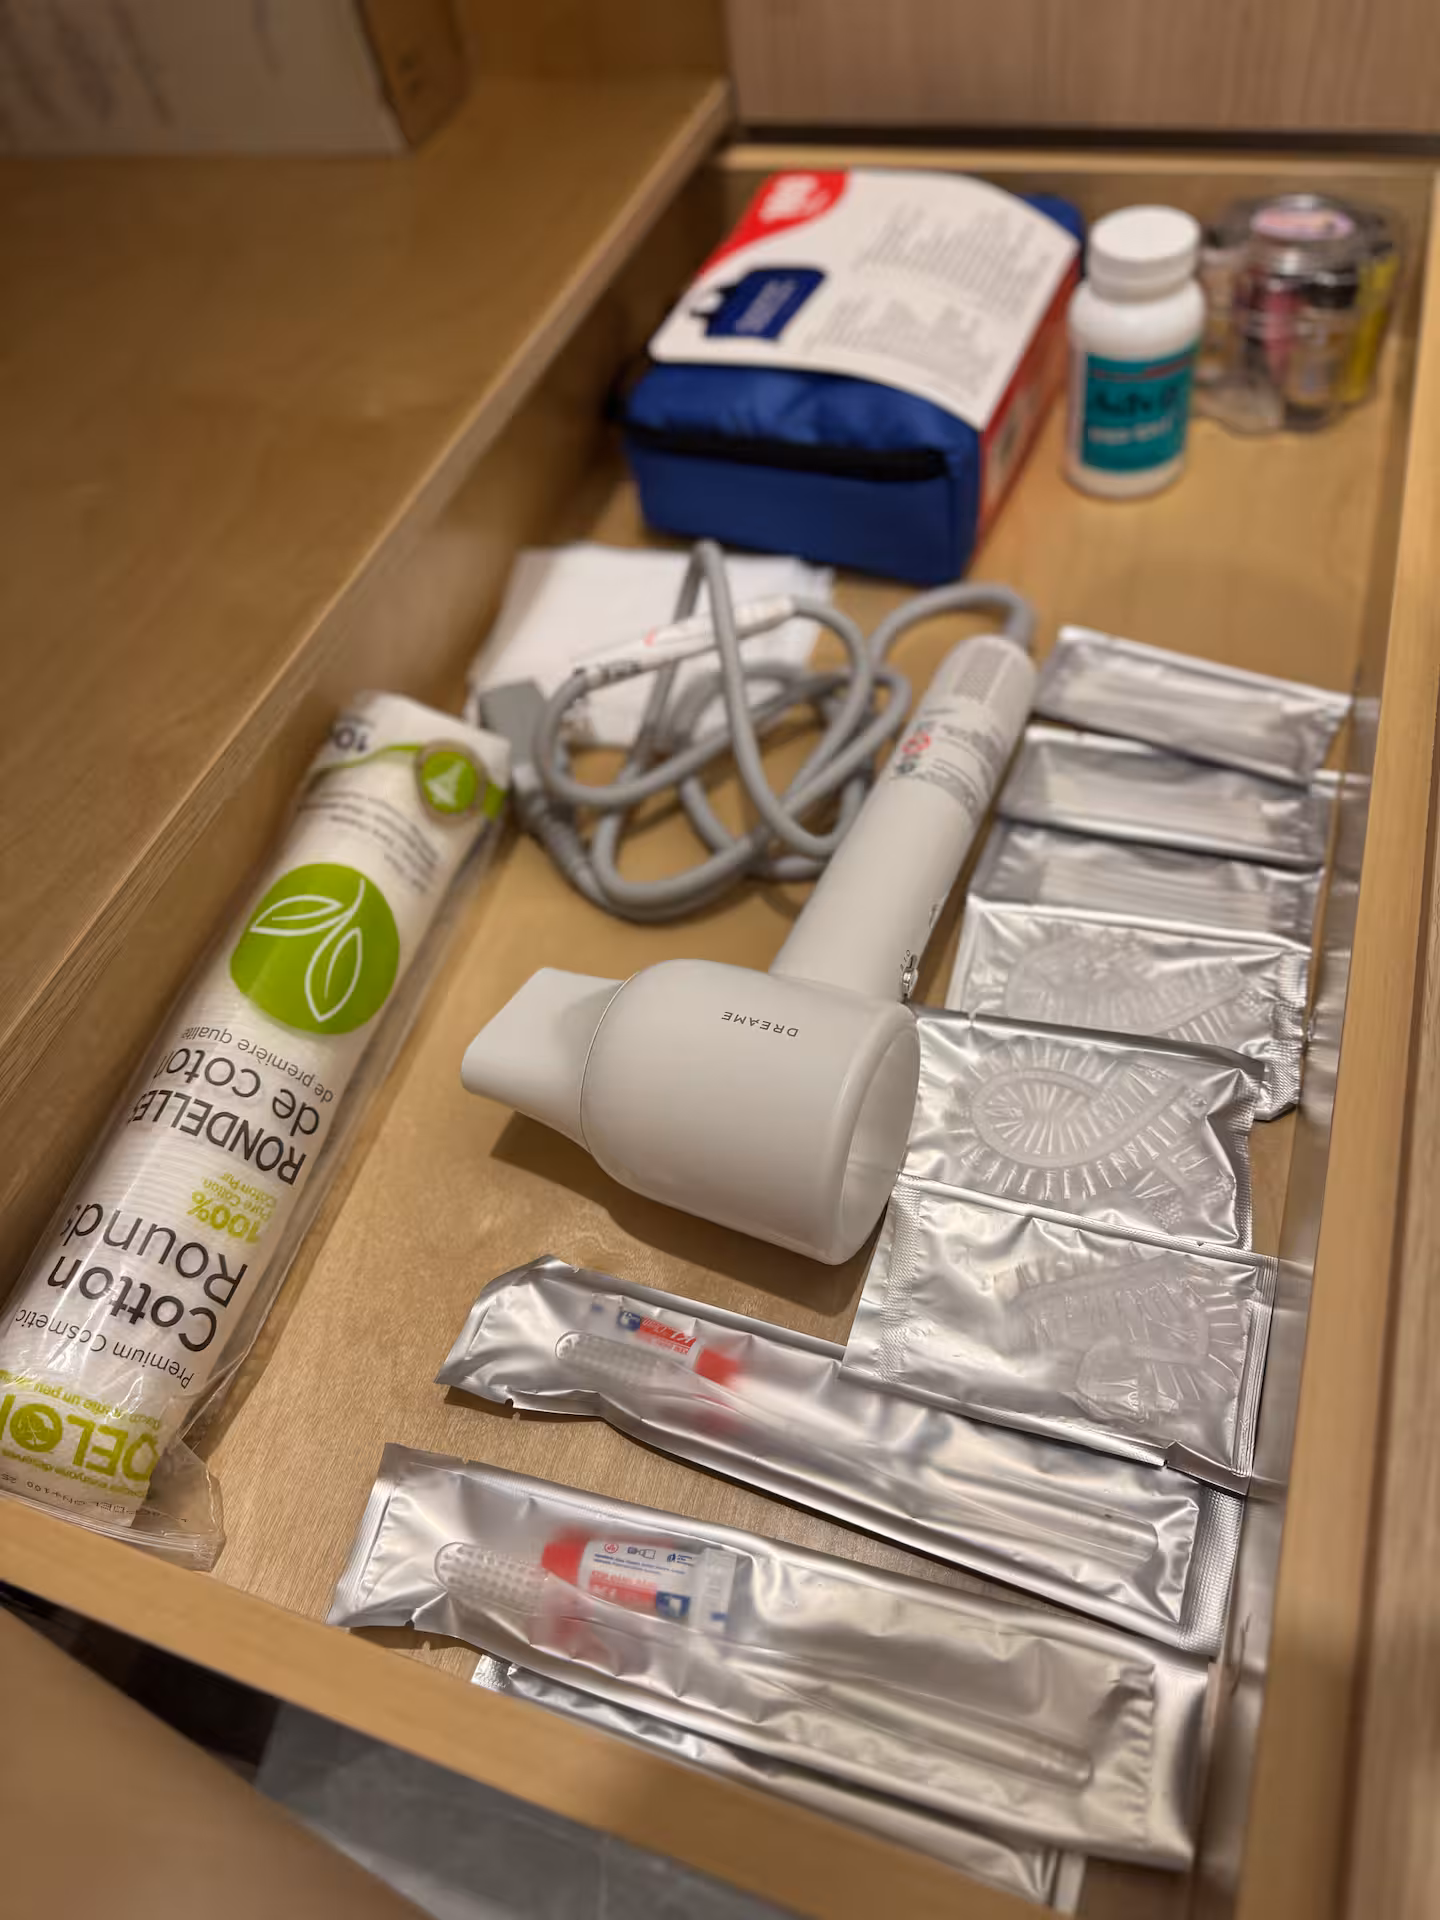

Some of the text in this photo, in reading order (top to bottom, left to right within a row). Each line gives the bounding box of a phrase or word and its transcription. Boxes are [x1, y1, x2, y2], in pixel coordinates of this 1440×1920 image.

[721, 1011, 799, 1037] DREAME
[237, 1037, 315, 1082] première
[272, 1088, 320, 1137] de
[314, 1086, 334, 1104] de
[186, 1191, 261, 1243] 100%
[47, 1255, 217, 1353] Cotton
[15, 1308, 195, 1390] Premium Cosmetic
